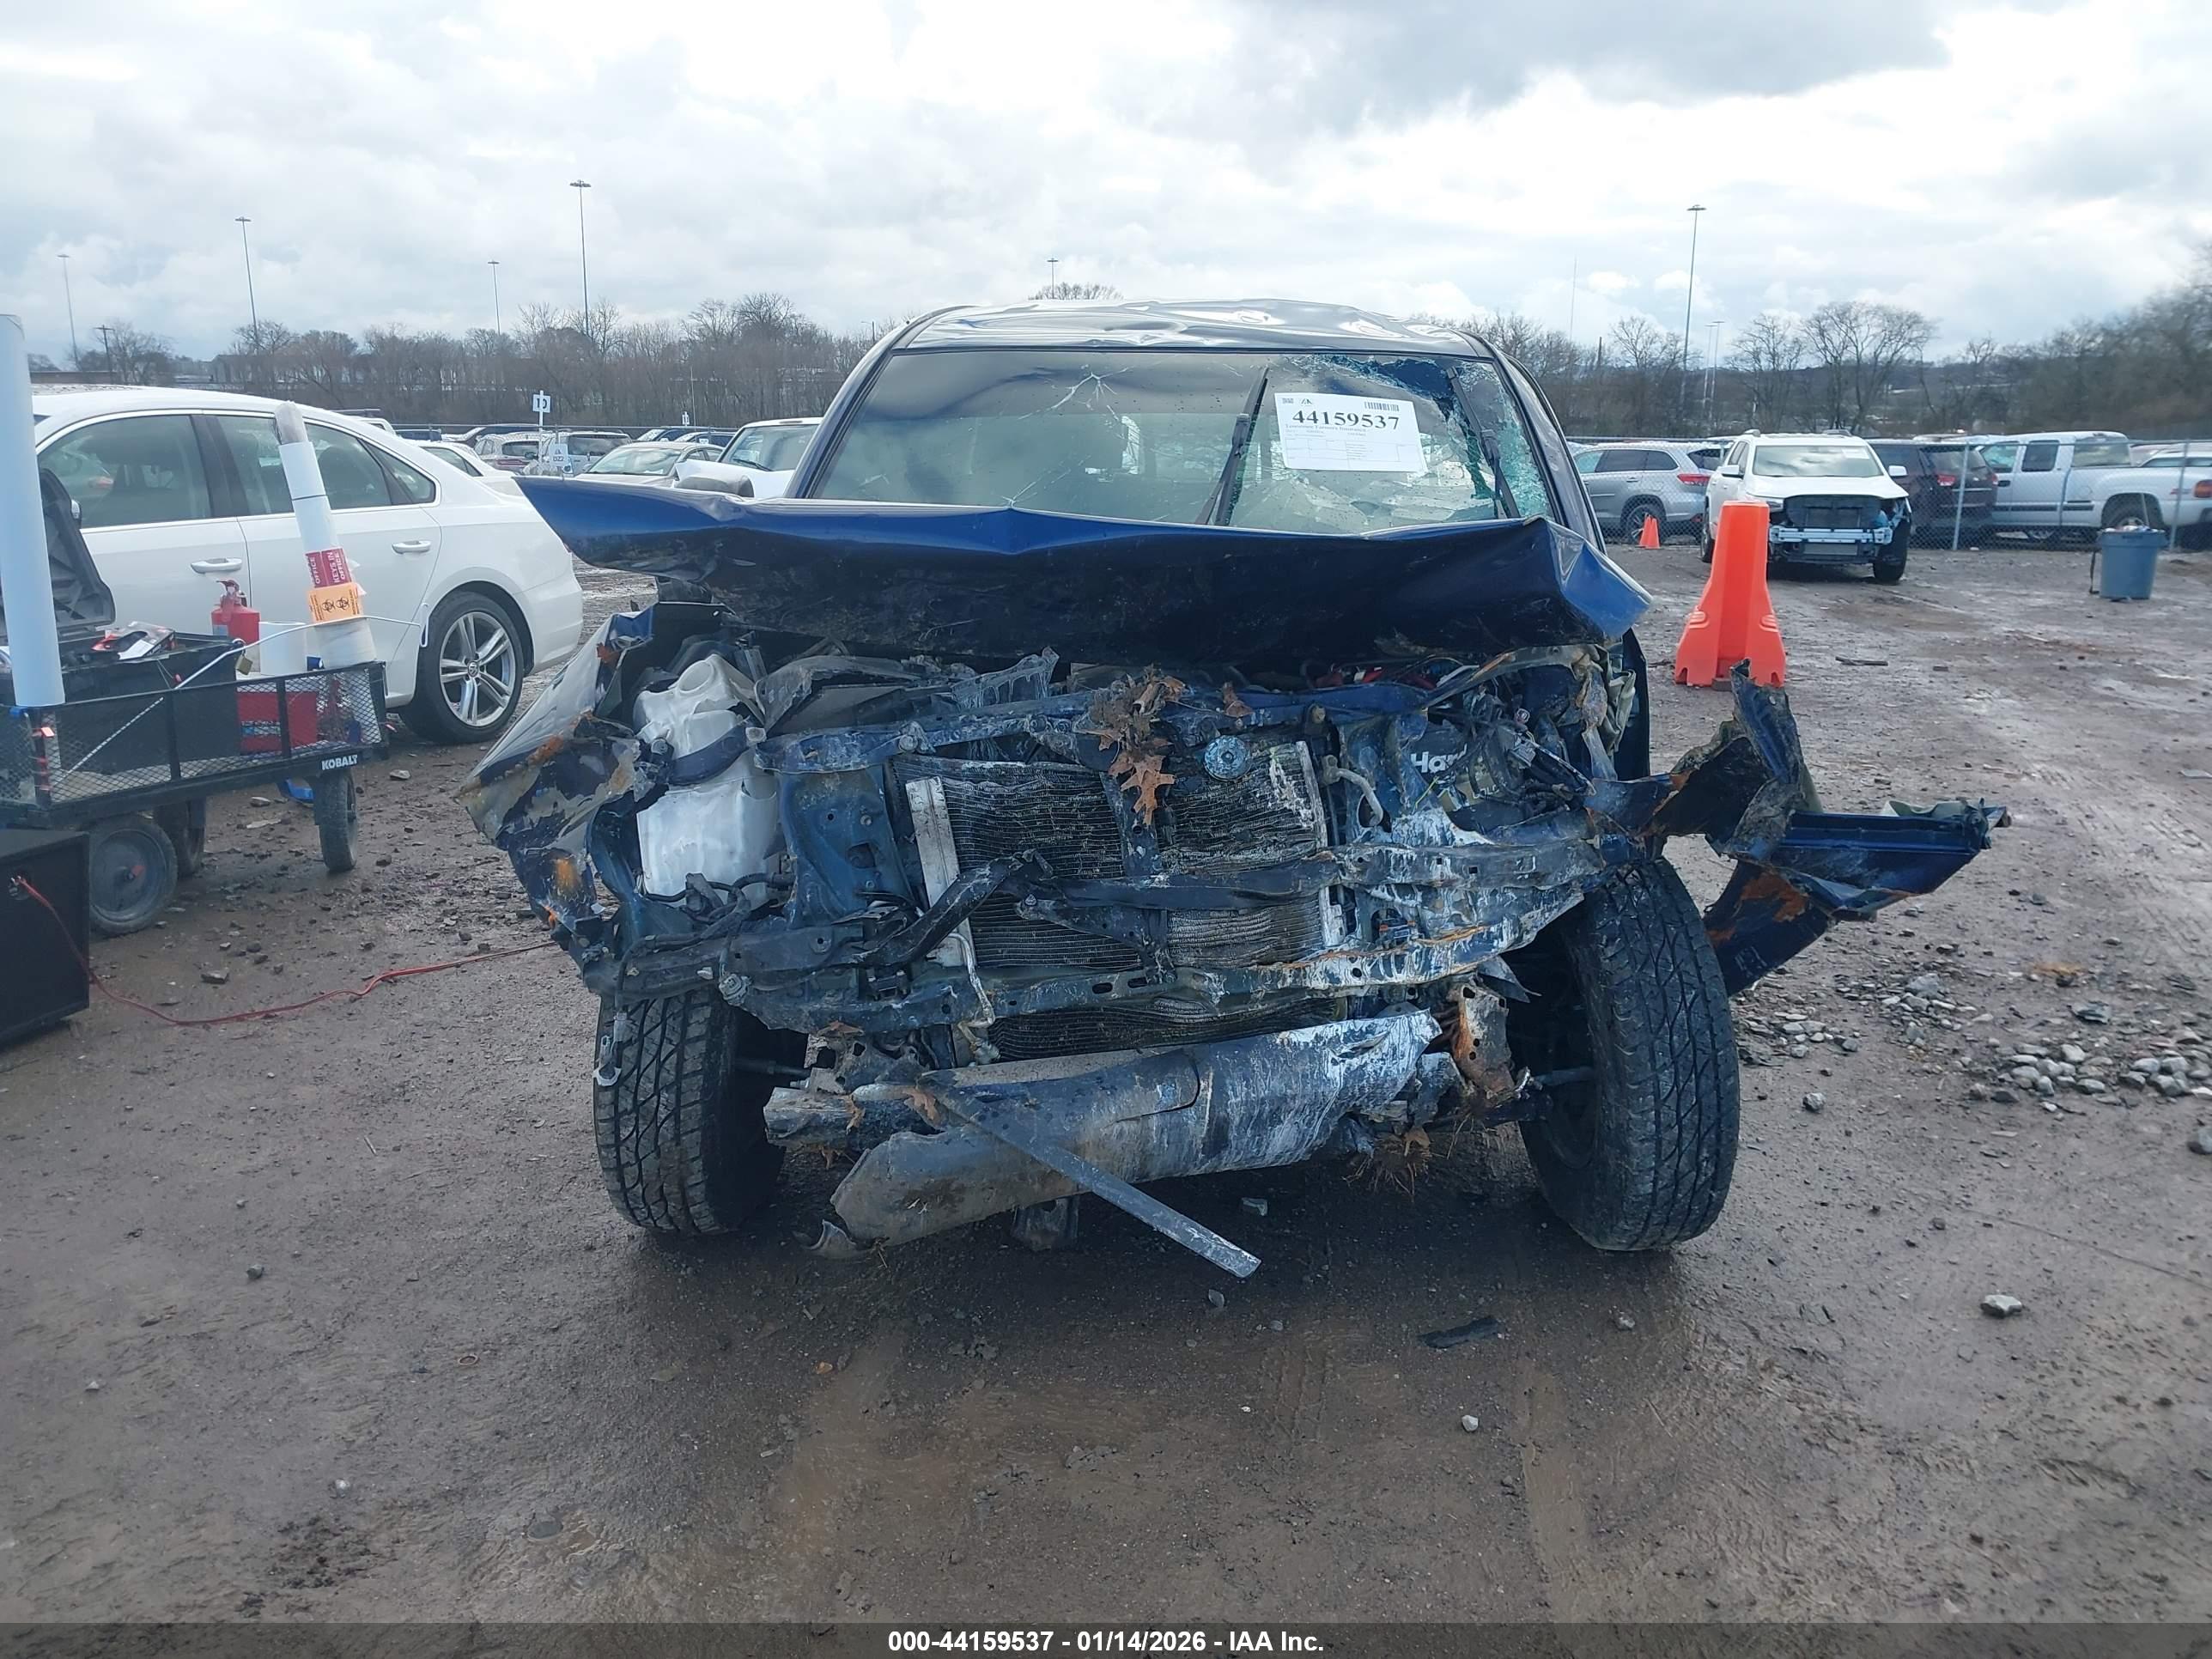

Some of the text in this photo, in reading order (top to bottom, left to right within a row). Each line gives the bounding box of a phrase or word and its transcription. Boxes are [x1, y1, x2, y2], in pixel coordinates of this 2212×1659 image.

[1291, 410, 1400, 430] 44159537
[310, 556, 321, 584] OFFICE
[326, 551, 340, 583] KEYS IN
[334, 552, 345, 580] OFFICE
[321, 754, 358, 771] KOBALT
